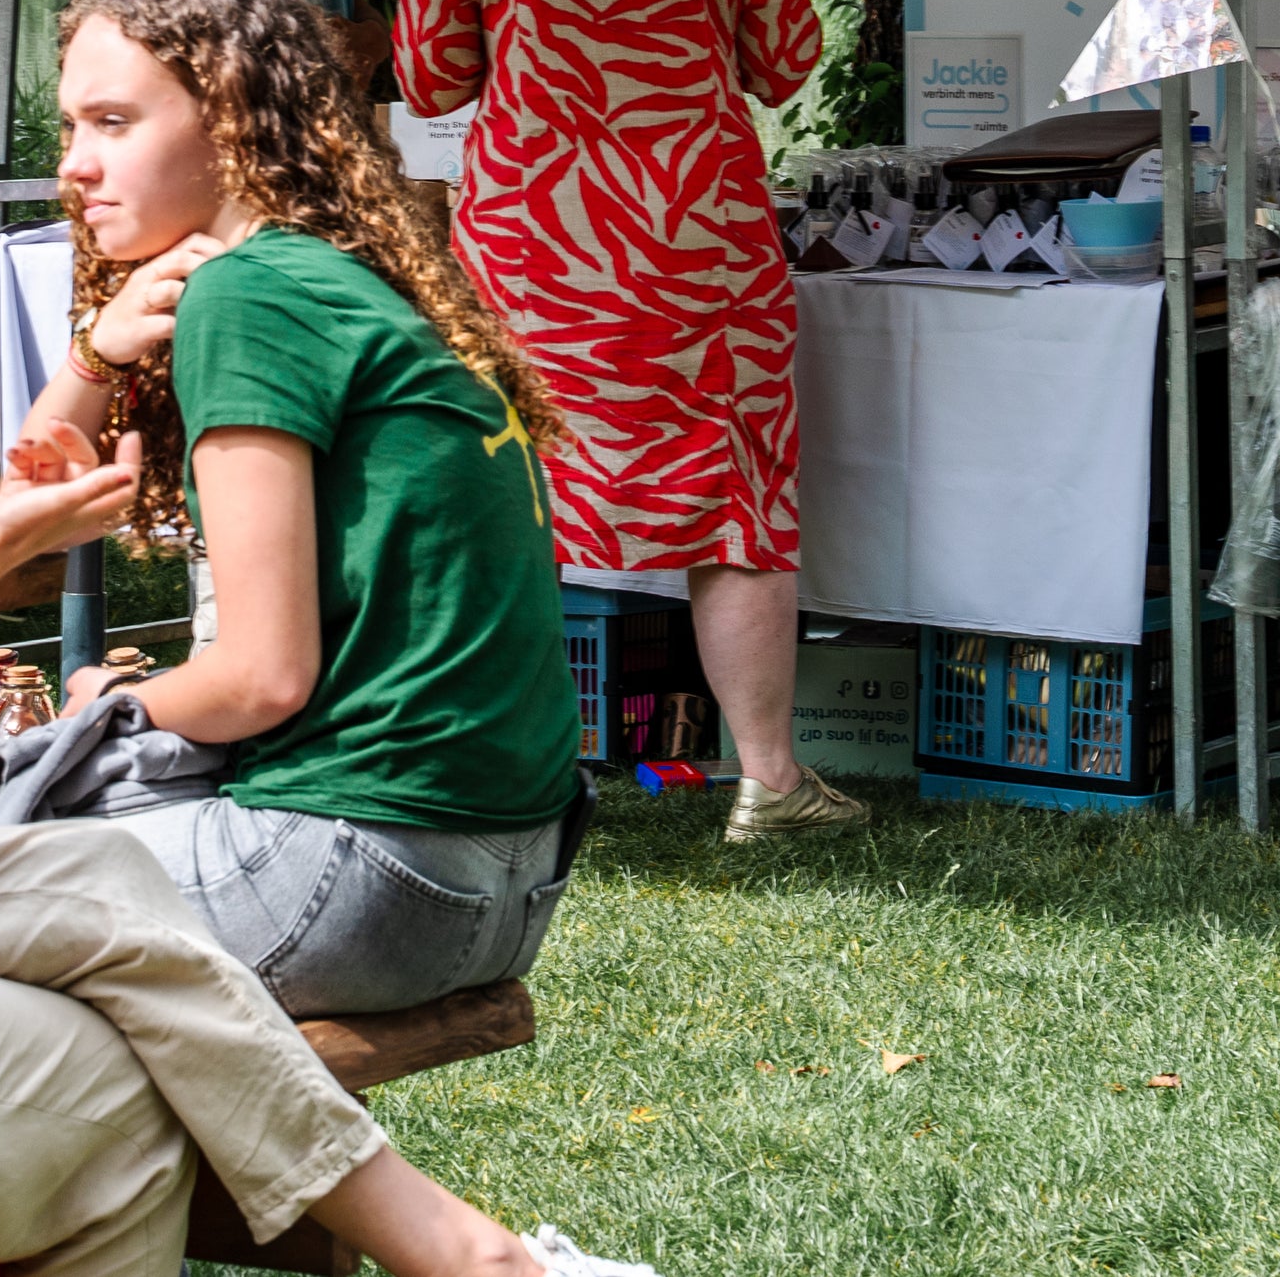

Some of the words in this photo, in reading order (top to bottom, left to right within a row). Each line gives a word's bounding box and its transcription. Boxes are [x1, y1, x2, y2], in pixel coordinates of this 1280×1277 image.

[923, 58, 1008, 85] Jackie
[922, 89, 966, 99] verbindt
[968, 91, 995, 100] mens
[427, 121, 449, 130] Feng
[974, 122, 1008, 132] ruimte
[792, 707, 909, 724] @safecourtkitc
[799, 729, 822, 746] al?
[826, 729, 855, 741] ons
[858, 728, 872, 745] jij
[876, 729, 910, 746] volg
